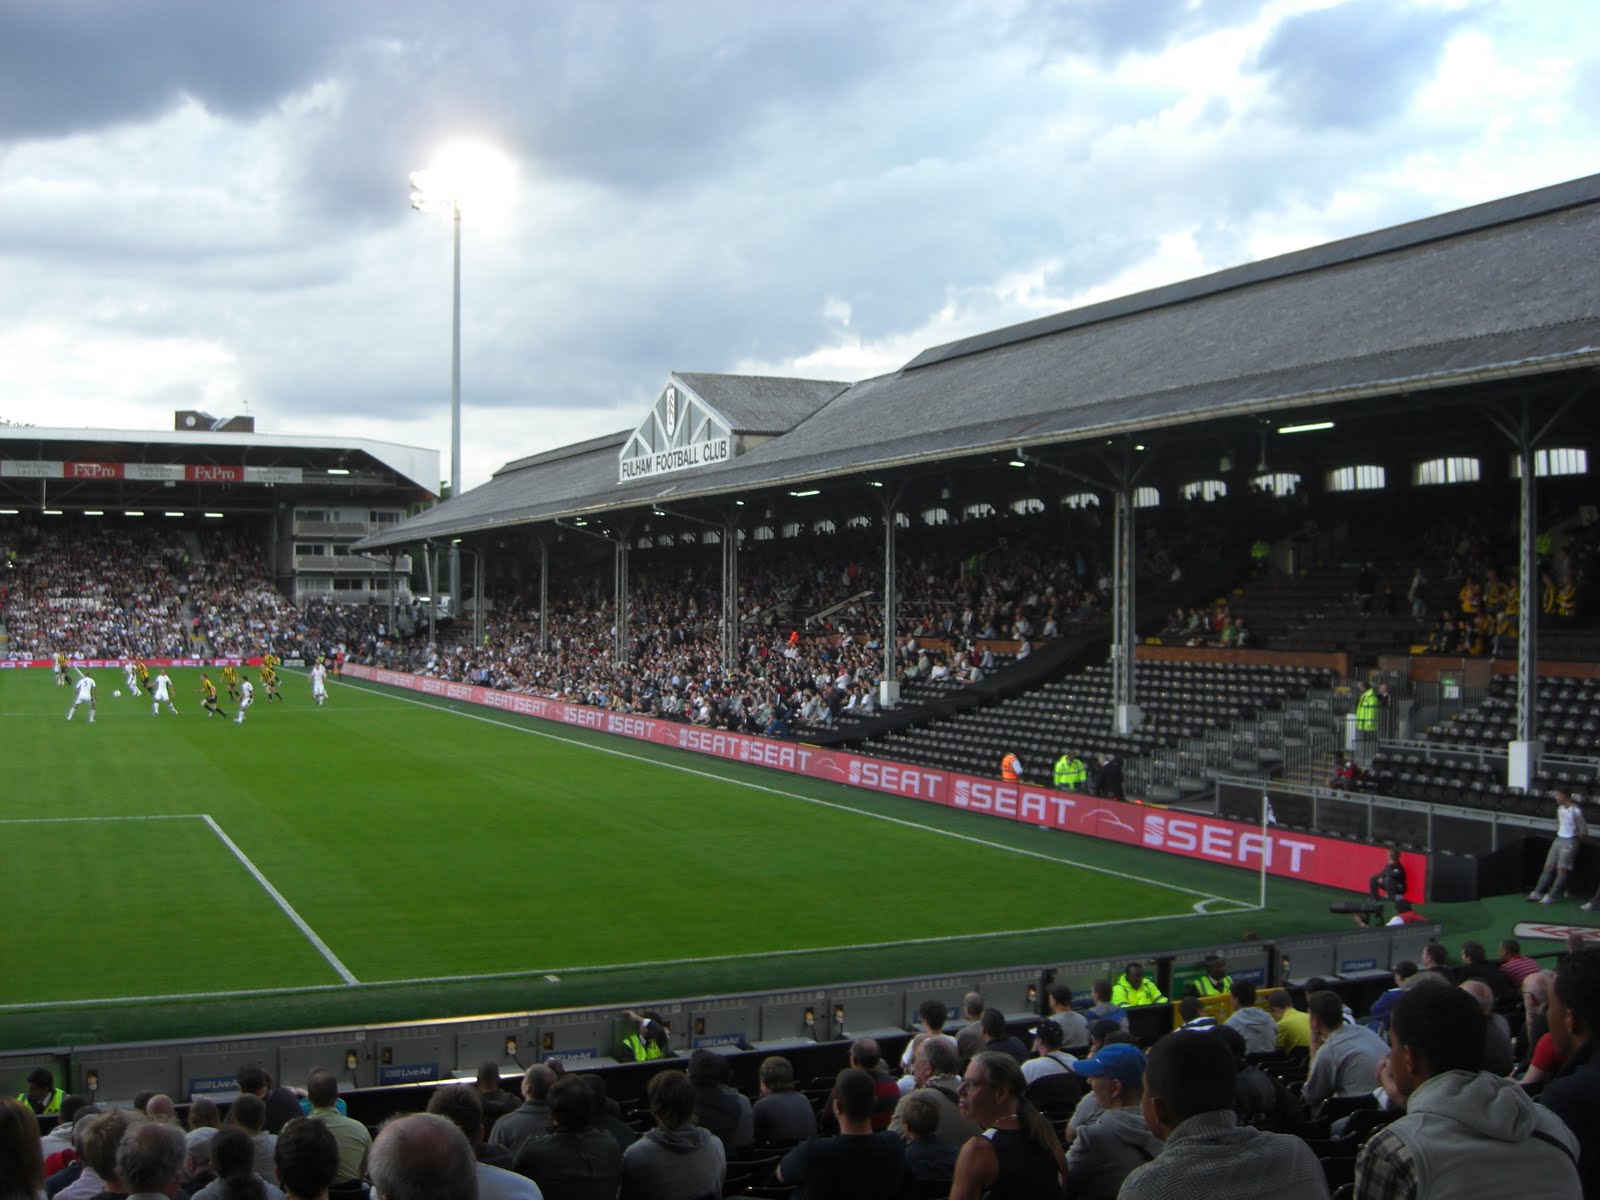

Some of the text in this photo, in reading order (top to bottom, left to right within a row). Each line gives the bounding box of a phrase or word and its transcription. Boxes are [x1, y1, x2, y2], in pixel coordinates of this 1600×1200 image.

[74, 463, 115, 477] FxPro
[622, 440, 727, 479] FULHAM FOOTBALL CLUB
[195, 465, 235, 480] FxPro
[488, 692, 514, 709] SEAT
[518, 697, 548, 716] SEAT
[569, 708, 604, 728] SEAT
[615, 716, 656, 738] SEAT
[688, 730, 739, 756] SEAT
[750, 741, 812, 771] SEAT
[862, 763, 943, 798] SEAT
[971, 783, 1075, 824] SEAT
[1167, 819, 1316, 873] SEAT
[401, 1067, 433, 1077] LiveAd
[212, 1079, 241, 1089] LiveA
